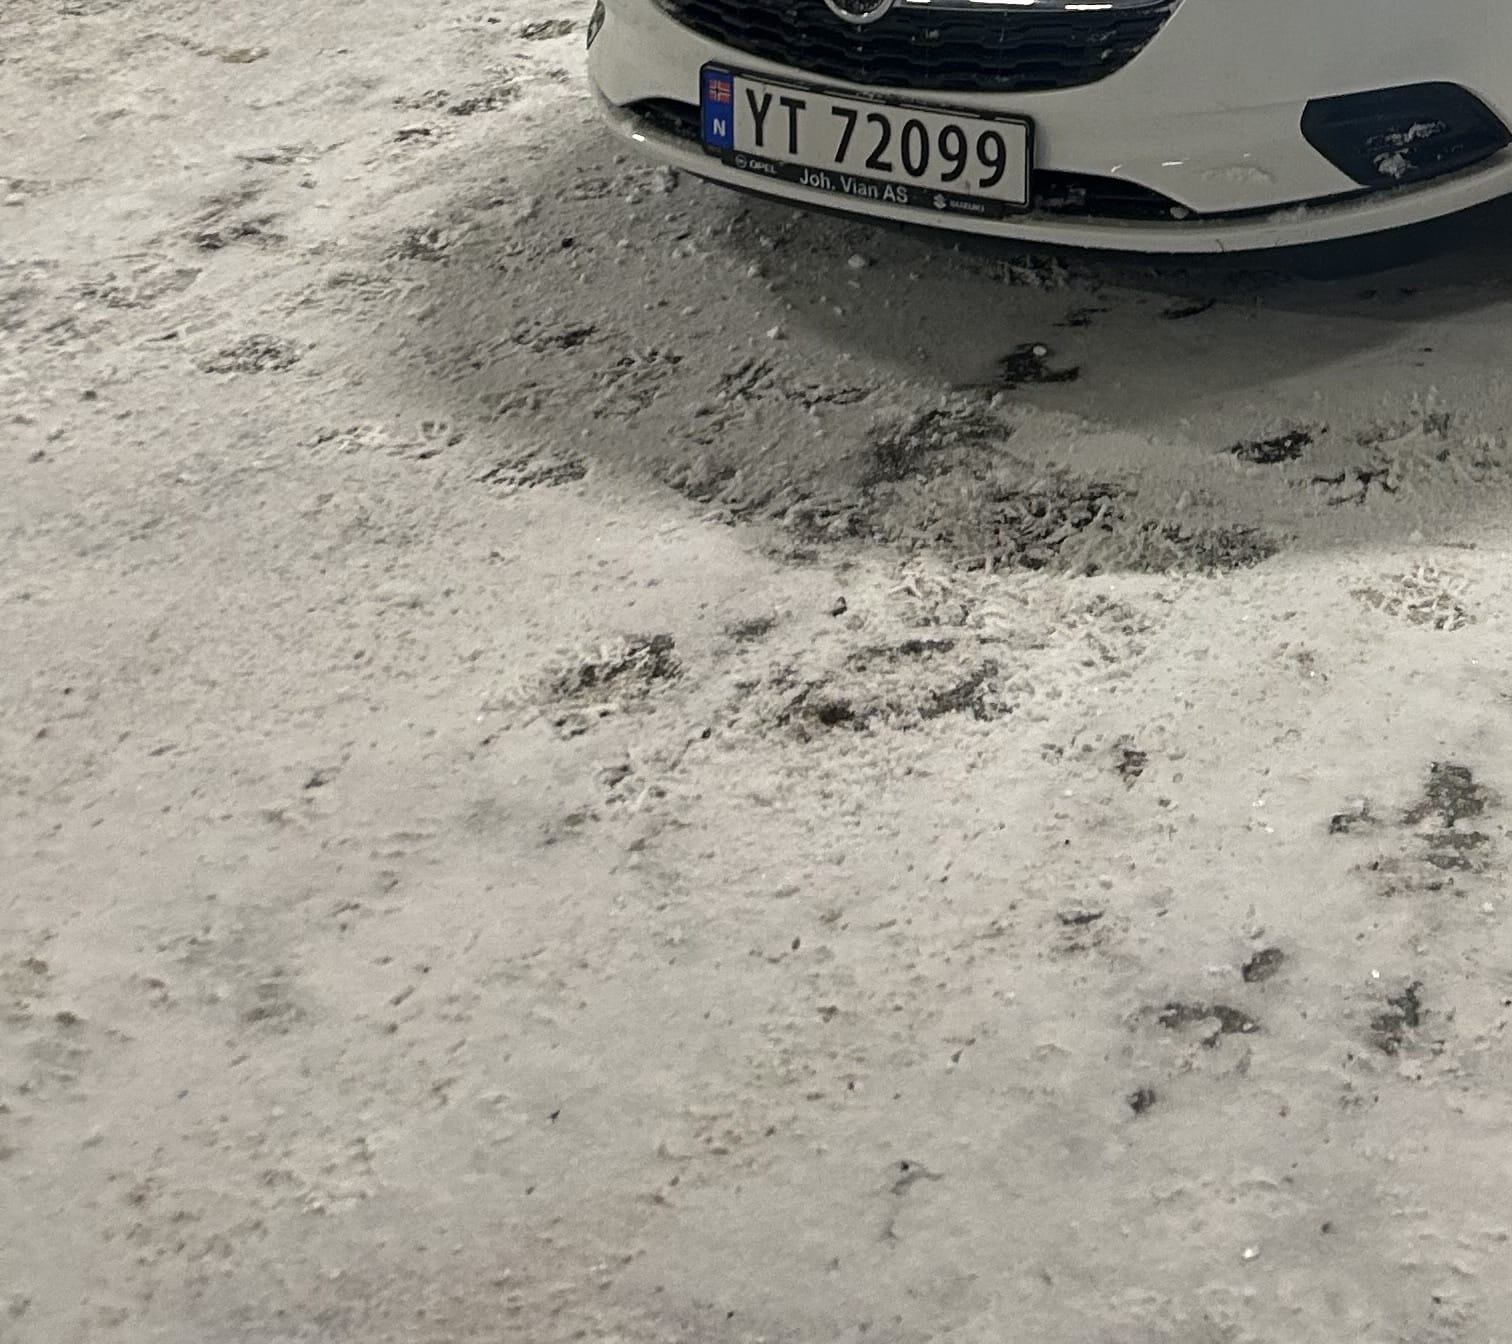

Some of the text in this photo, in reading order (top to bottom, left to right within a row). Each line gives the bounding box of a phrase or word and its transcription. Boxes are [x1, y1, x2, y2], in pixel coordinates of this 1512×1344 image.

[713, 118, 726, 137] N
[745, 87, 1007, 188] YT 72099
[800, 168, 909, 204] Joh. Vian AS
